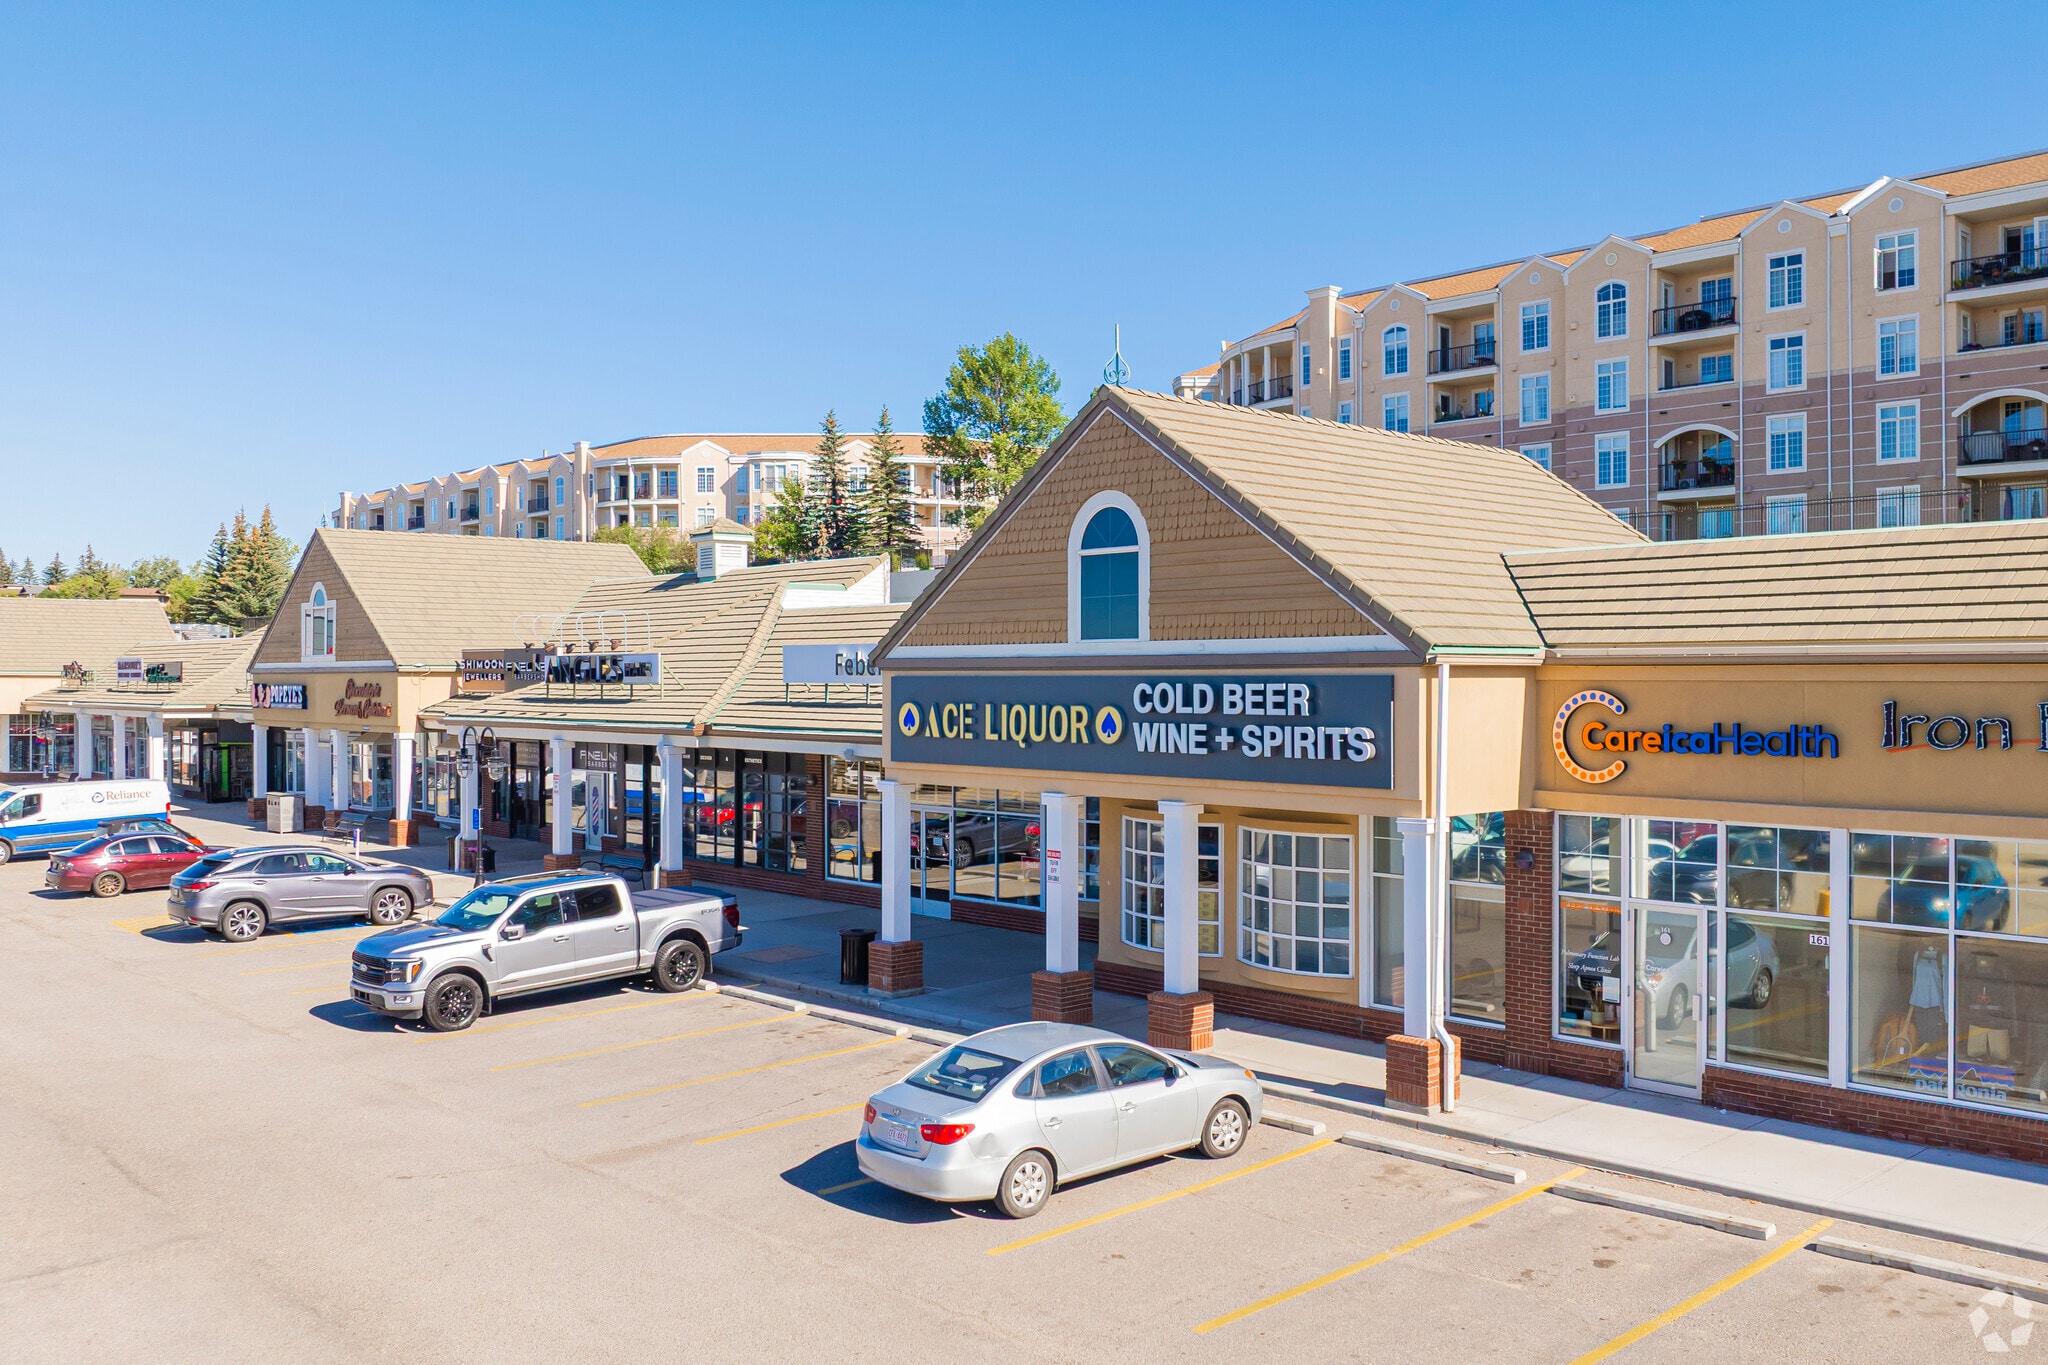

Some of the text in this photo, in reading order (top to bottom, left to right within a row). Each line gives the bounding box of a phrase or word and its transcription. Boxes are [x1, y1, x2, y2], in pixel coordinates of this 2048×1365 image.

[460, 659, 504, 669] SHIMOON
[545, 655, 624, 683] ANGLES
[463, 672, 502, 681] JEWELLERS
[270, 685, 303, 703] POPEYE'S
[1132, 682, 1310, 717] COLD BEER
[924, 703, 1091, 748] ACE LIQUOR
[1880, 700, 2012, 751] Iron
[1132, 721, 1377, 763] WINE + SPIRITS
[1582, 721, 1840, 759] CareicaHealth
[106, 790, 152, 801] Reliance
[1587, 903, 1621, 914] TESTING
[1810, 935, 1829, 946] 161
[1587, 952, 1609, 961] Function
[1610, 954, 1620, 962] Lab
[1580, 964, 1597, 973] Apnea
[1597, 965, 1612, 974] Clinic
